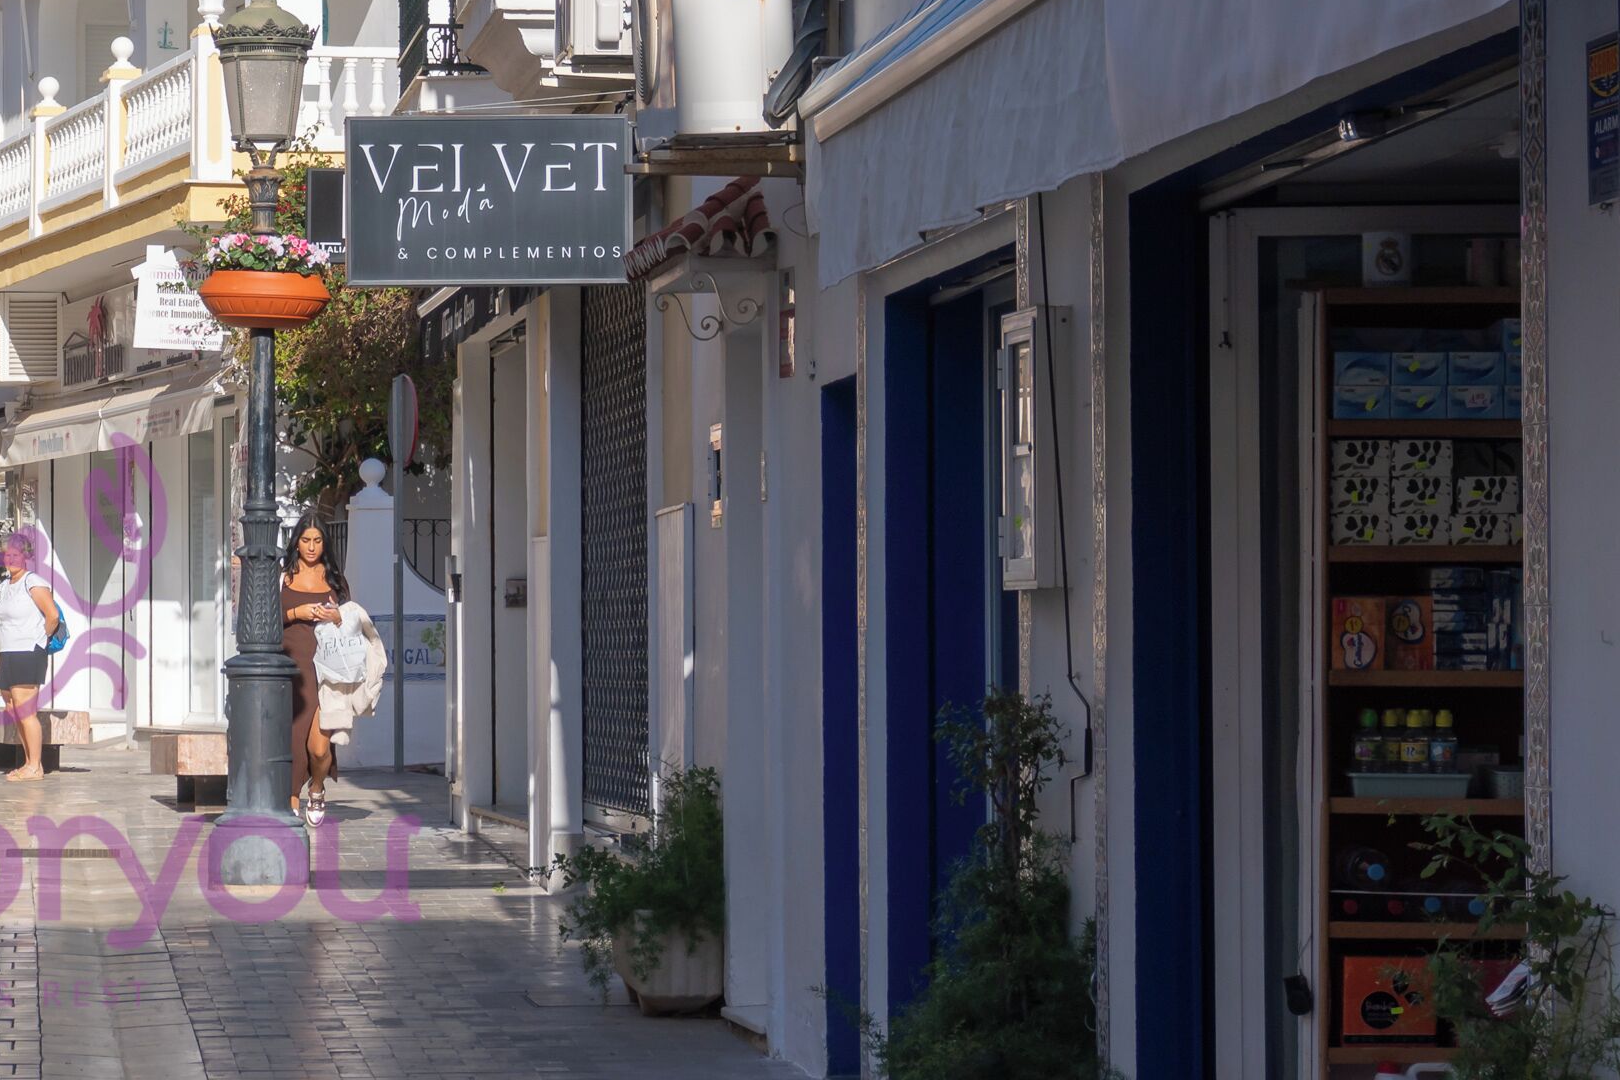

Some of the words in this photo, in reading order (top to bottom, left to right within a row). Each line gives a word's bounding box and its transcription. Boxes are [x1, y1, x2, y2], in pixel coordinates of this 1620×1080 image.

[359, 142, 617, 193] VELVET
[397, 188, 494, 241] Moda
[397, 248, 409, 260] &
[426, 246, 621, 260] COMPLEMENTOS
[159, 297, 177, 306] Real
[178, 298, 200, 308] Estate
[387, 649, 436, 665] NGAL
